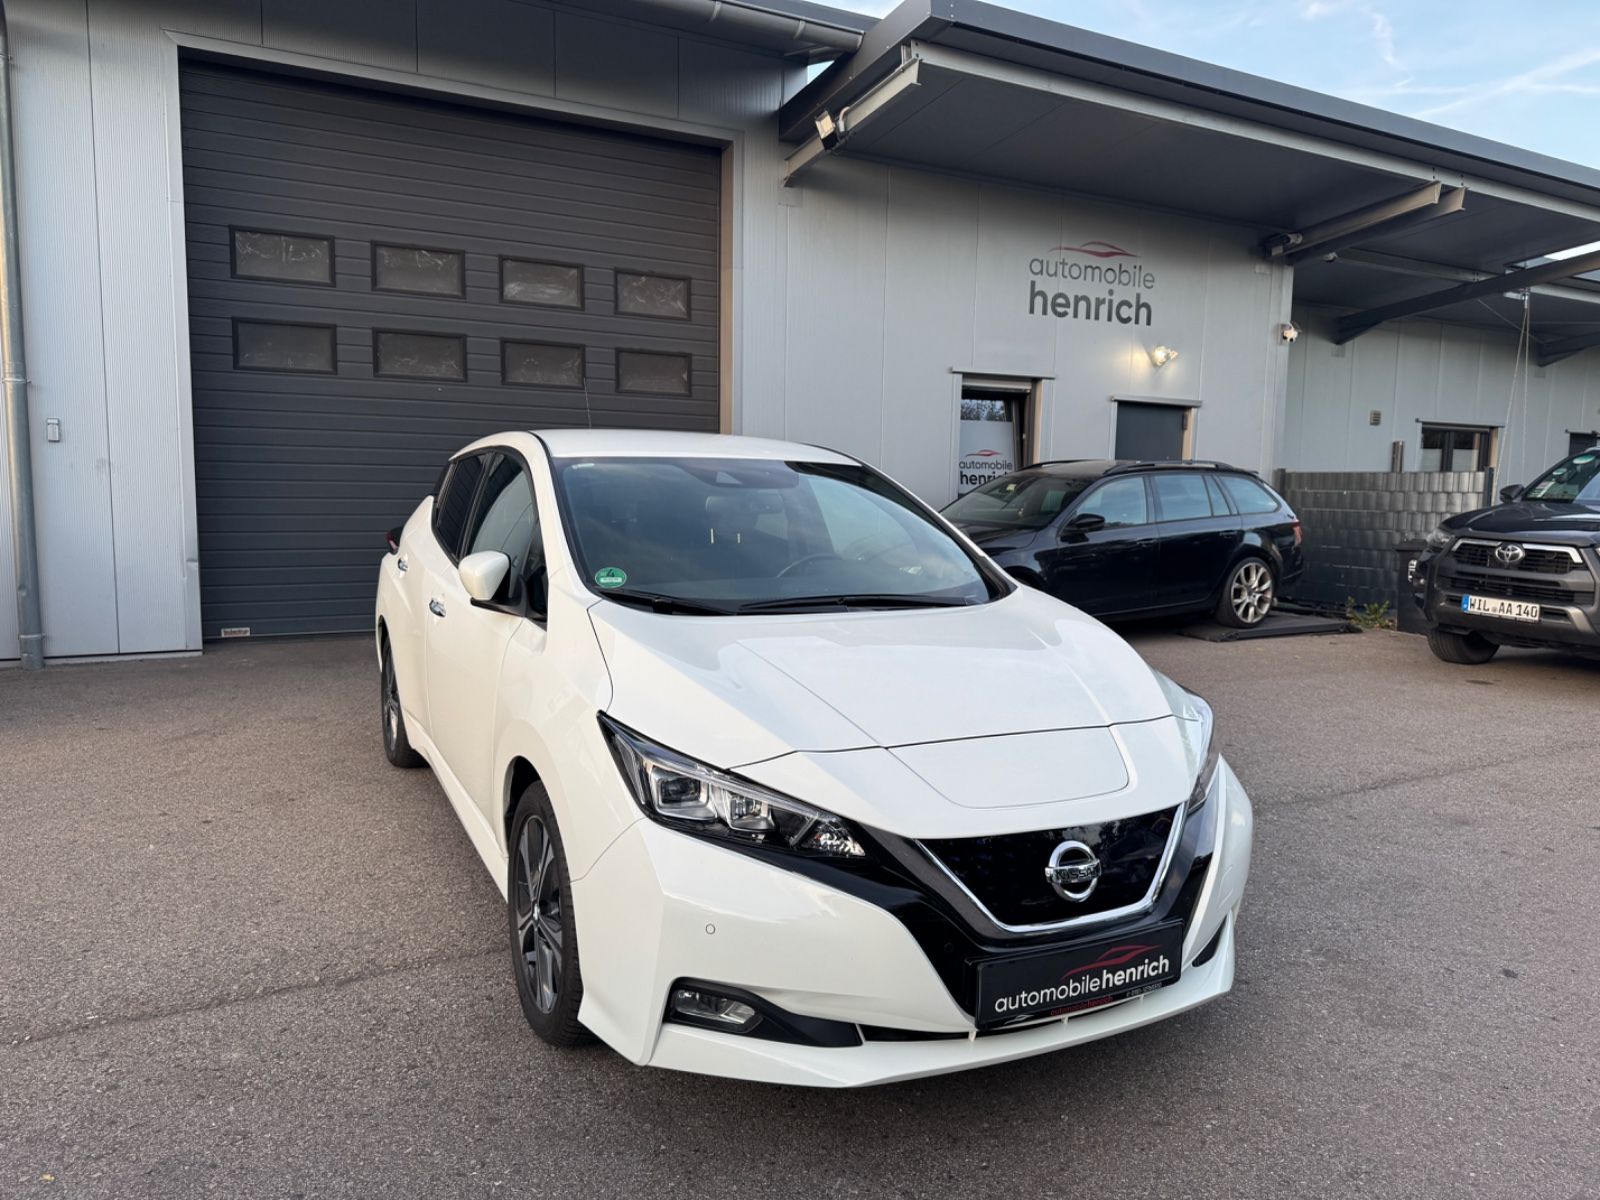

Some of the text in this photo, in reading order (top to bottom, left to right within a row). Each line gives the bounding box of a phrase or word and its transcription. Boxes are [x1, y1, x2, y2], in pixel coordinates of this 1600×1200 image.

[1029, 258, 1155, 289] automobile
[1029, 280, 1152, 327] henrich
[959, 460, 1013, 470] automobile
[960, 470, 1007, 485] henri
[1499, 601, 1513, 614] AA
[1516, 604, 1538, 618] 140
